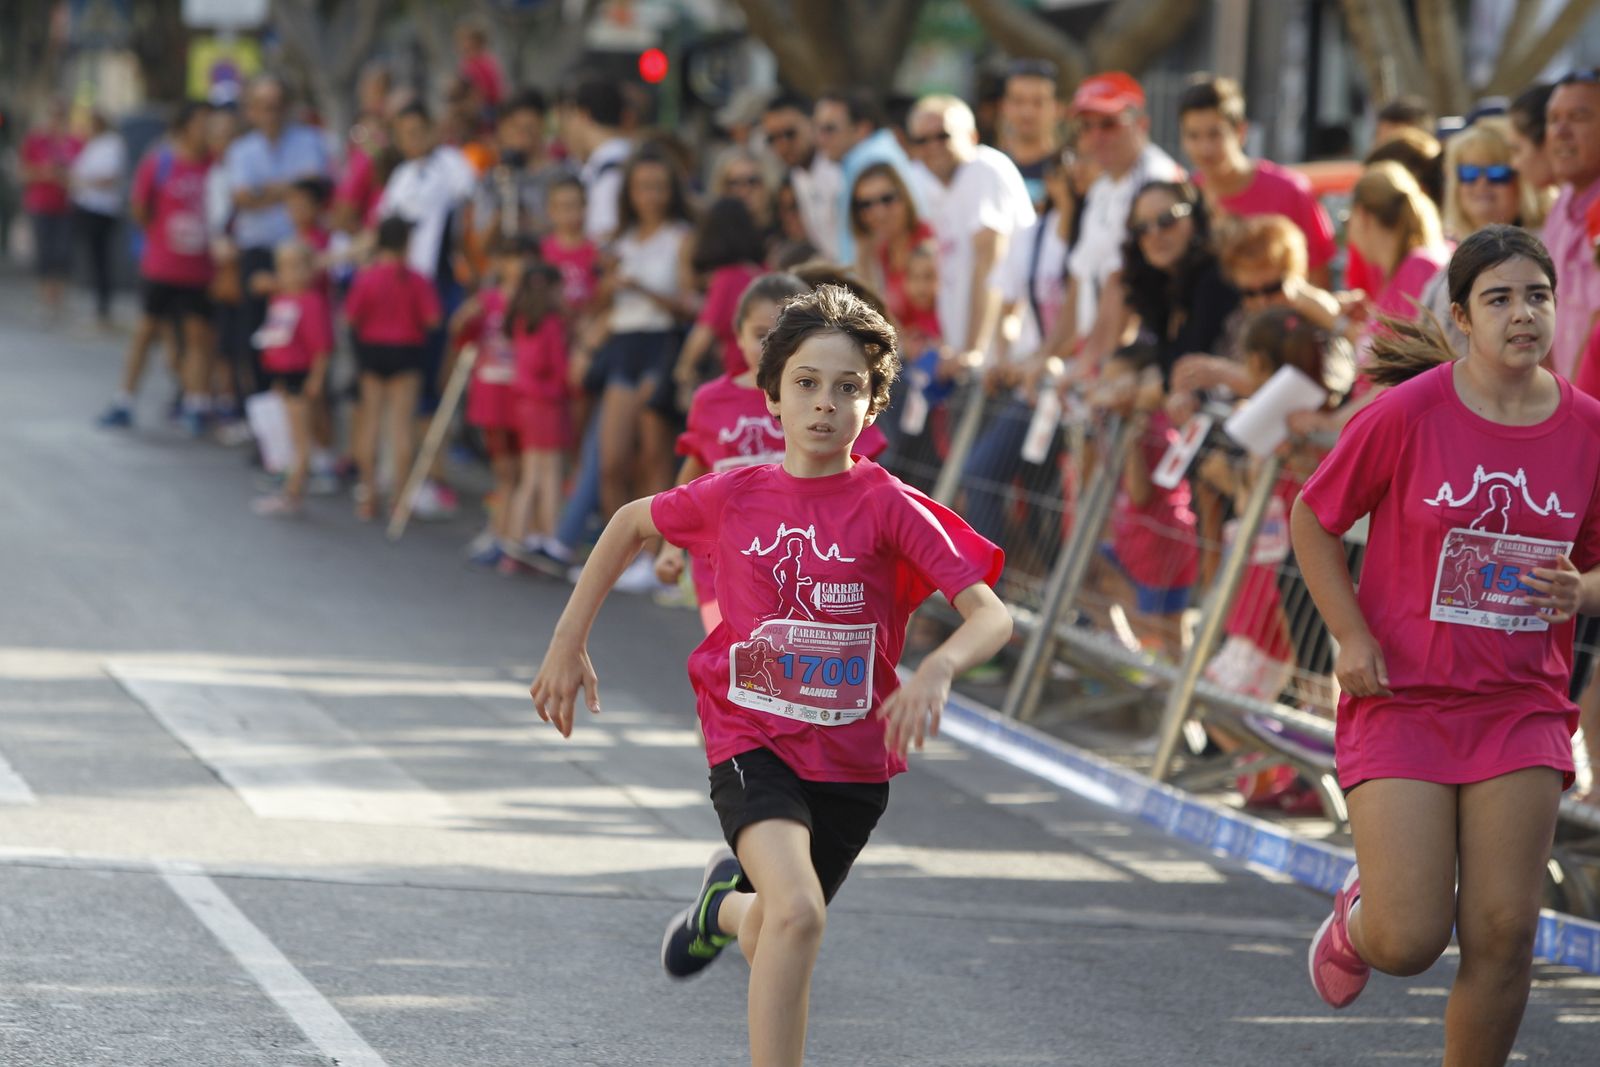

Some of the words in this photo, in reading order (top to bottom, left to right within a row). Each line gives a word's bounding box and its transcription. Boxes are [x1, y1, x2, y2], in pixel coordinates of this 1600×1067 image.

[822, 583, 864, 593] CARRERA
[822, 592, 863, 603] SOLIDARIA
[1481, 592, 1486, 600] I
[1487, 593, 1509, 604] LOVE
[785, 626, 794, 644] 4
[793, 627, 832, 639] CARRERA
[832, 630, 870, 641] SOLIDARIA
[777, 654, 865, 686] 1700
[800, 686, 837, 698] MANUEL
